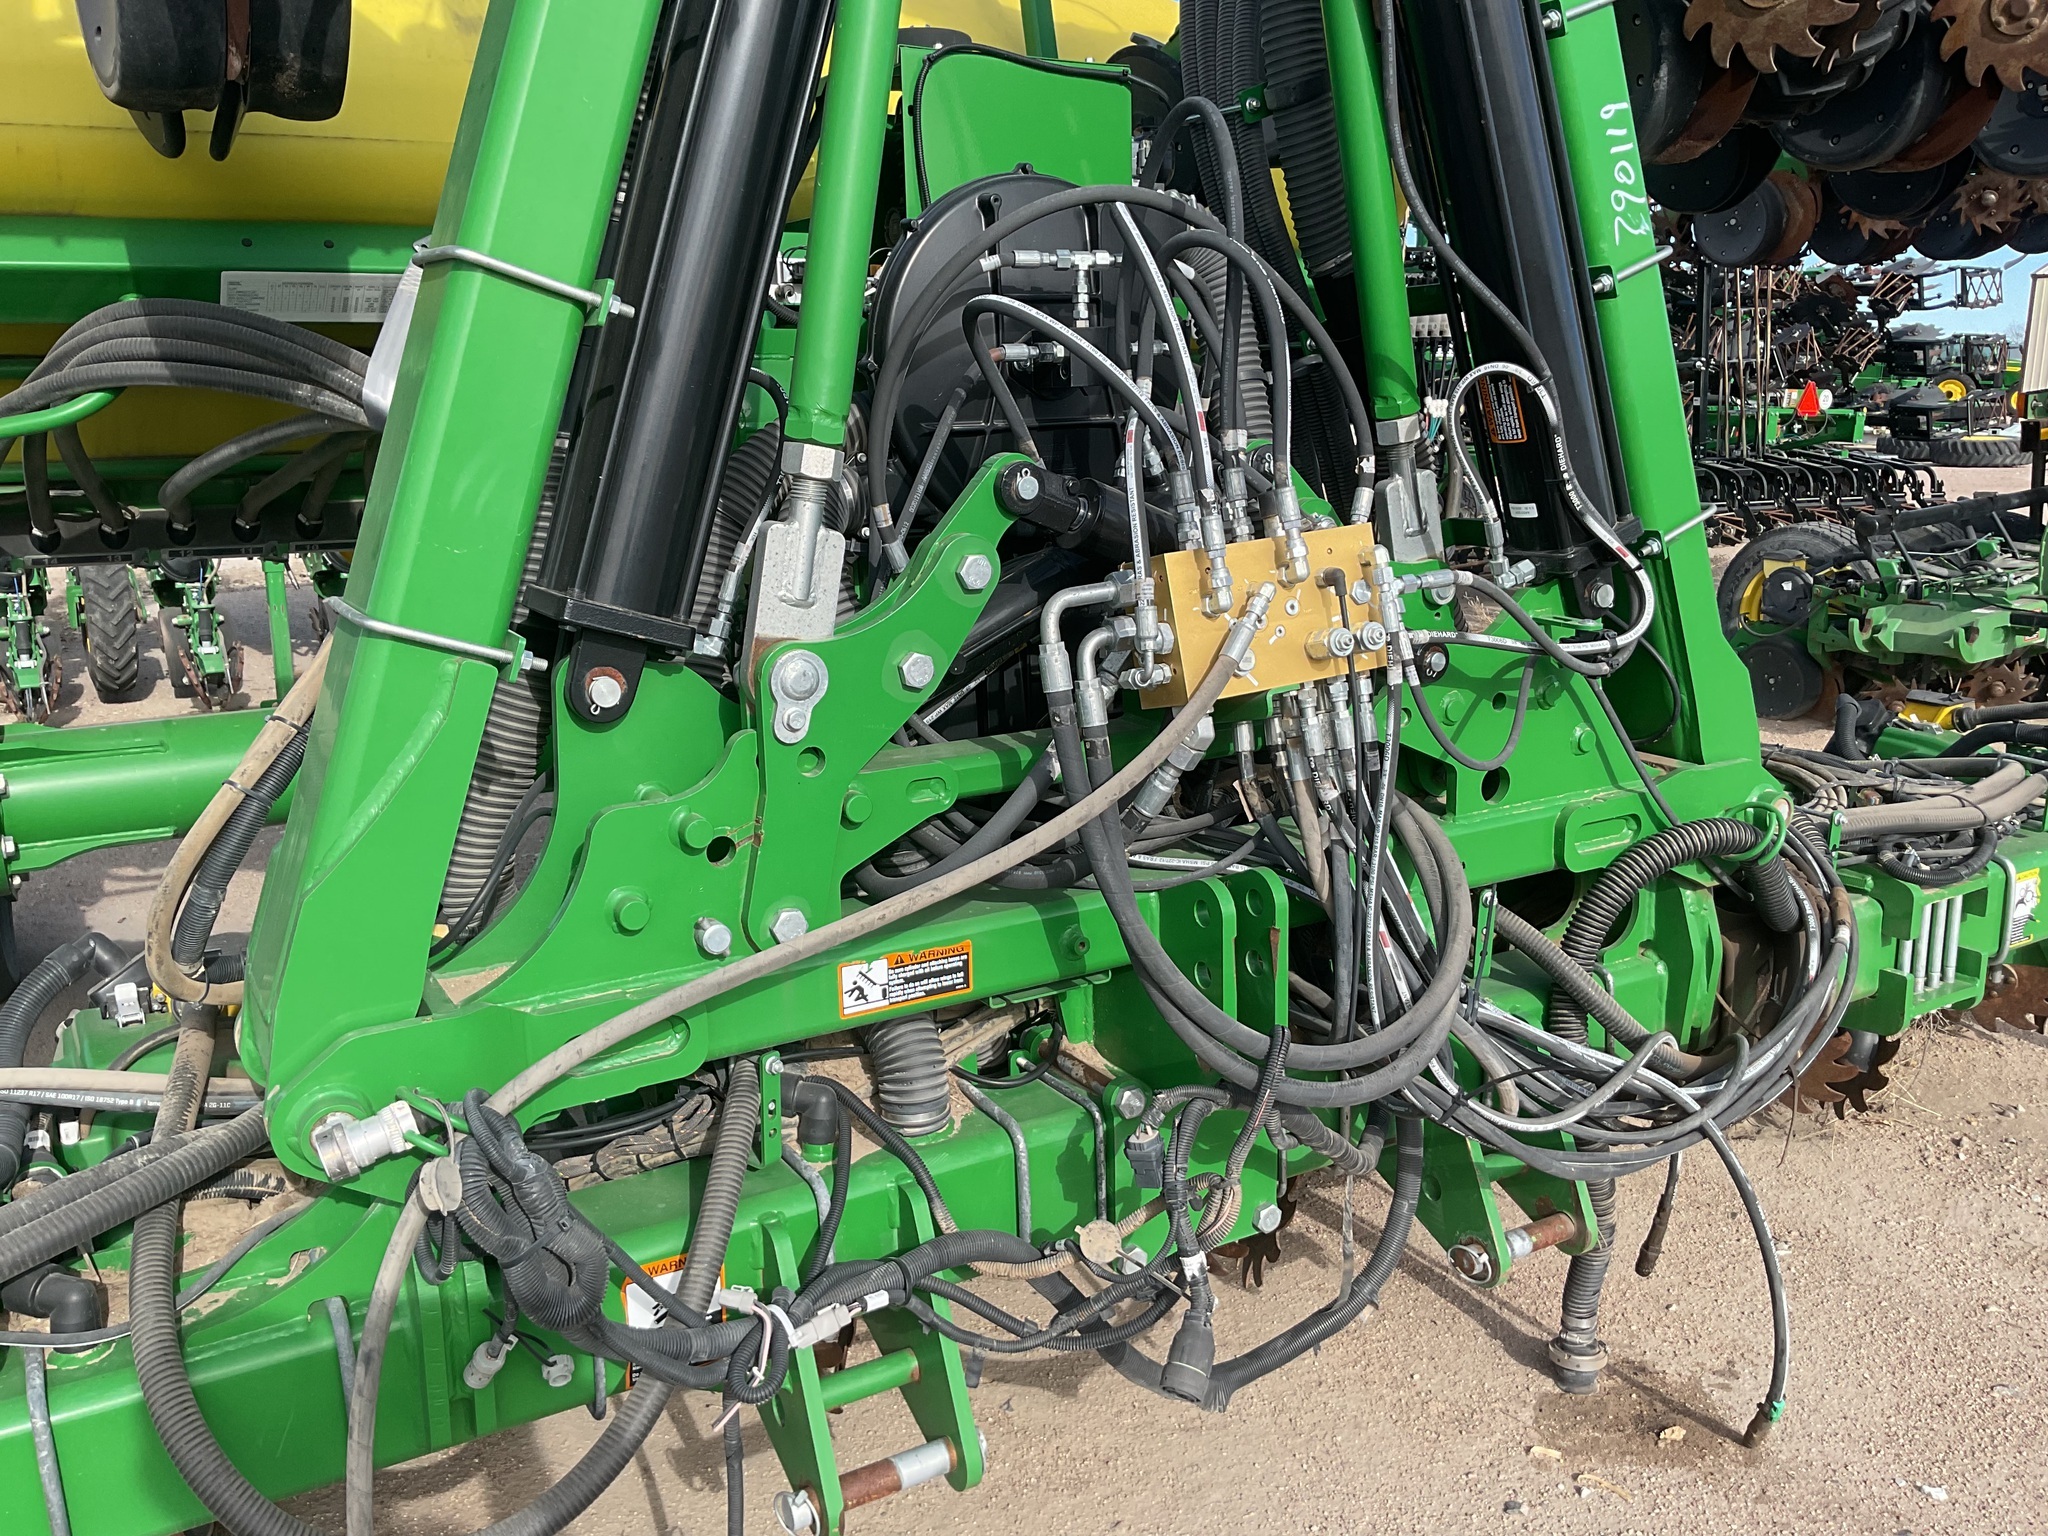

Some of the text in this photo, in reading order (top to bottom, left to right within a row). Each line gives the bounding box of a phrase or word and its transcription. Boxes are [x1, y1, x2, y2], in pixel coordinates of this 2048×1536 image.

[1162, 290, 1176, 320] ABRASION
[1174, 321, 1188, 358] RESISTANT
[1160, 418, 1180, 450] ABRASION
[1554, 436, 1567, 472] DIEHARD
[1128, 487, 1137, 522] RESISTANT
[1568, 491, 1583, 511] T3000
[1132, 522, 1142, 558] ABRASION
[908, 945, 965, 962] WARNING
[1368, 984, 1376, 1014] RESISTANT
[58, 1092, 80, 1100] 100R17
[648, 1258, 687, 1276] WARN
